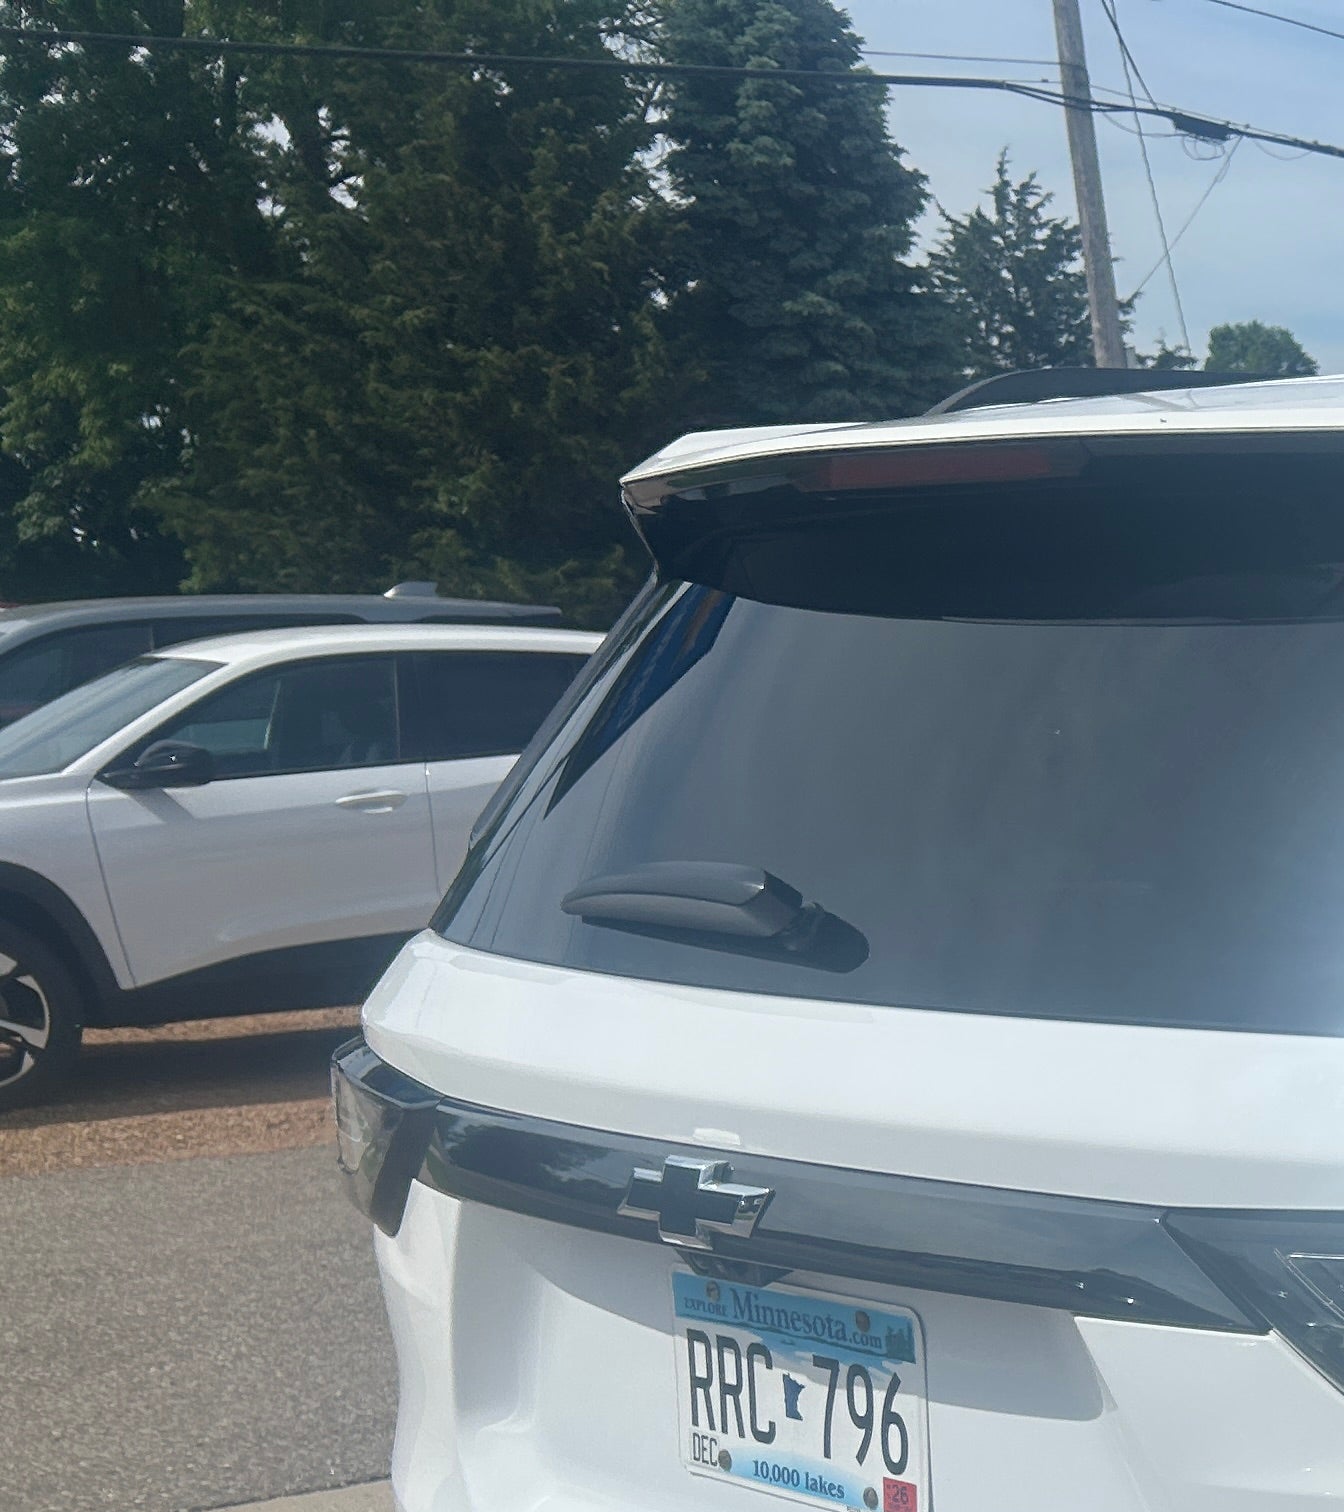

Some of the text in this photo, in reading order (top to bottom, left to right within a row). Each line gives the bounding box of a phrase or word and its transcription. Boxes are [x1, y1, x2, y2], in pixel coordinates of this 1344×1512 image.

[684, 1296, 728, 1317] EXPLORE
[686, 1328, 909, 1476] RRC 796
[692, 1432, 718, 1468] DEC
[752, 1459, 845, 1499] 10,000 lakes
